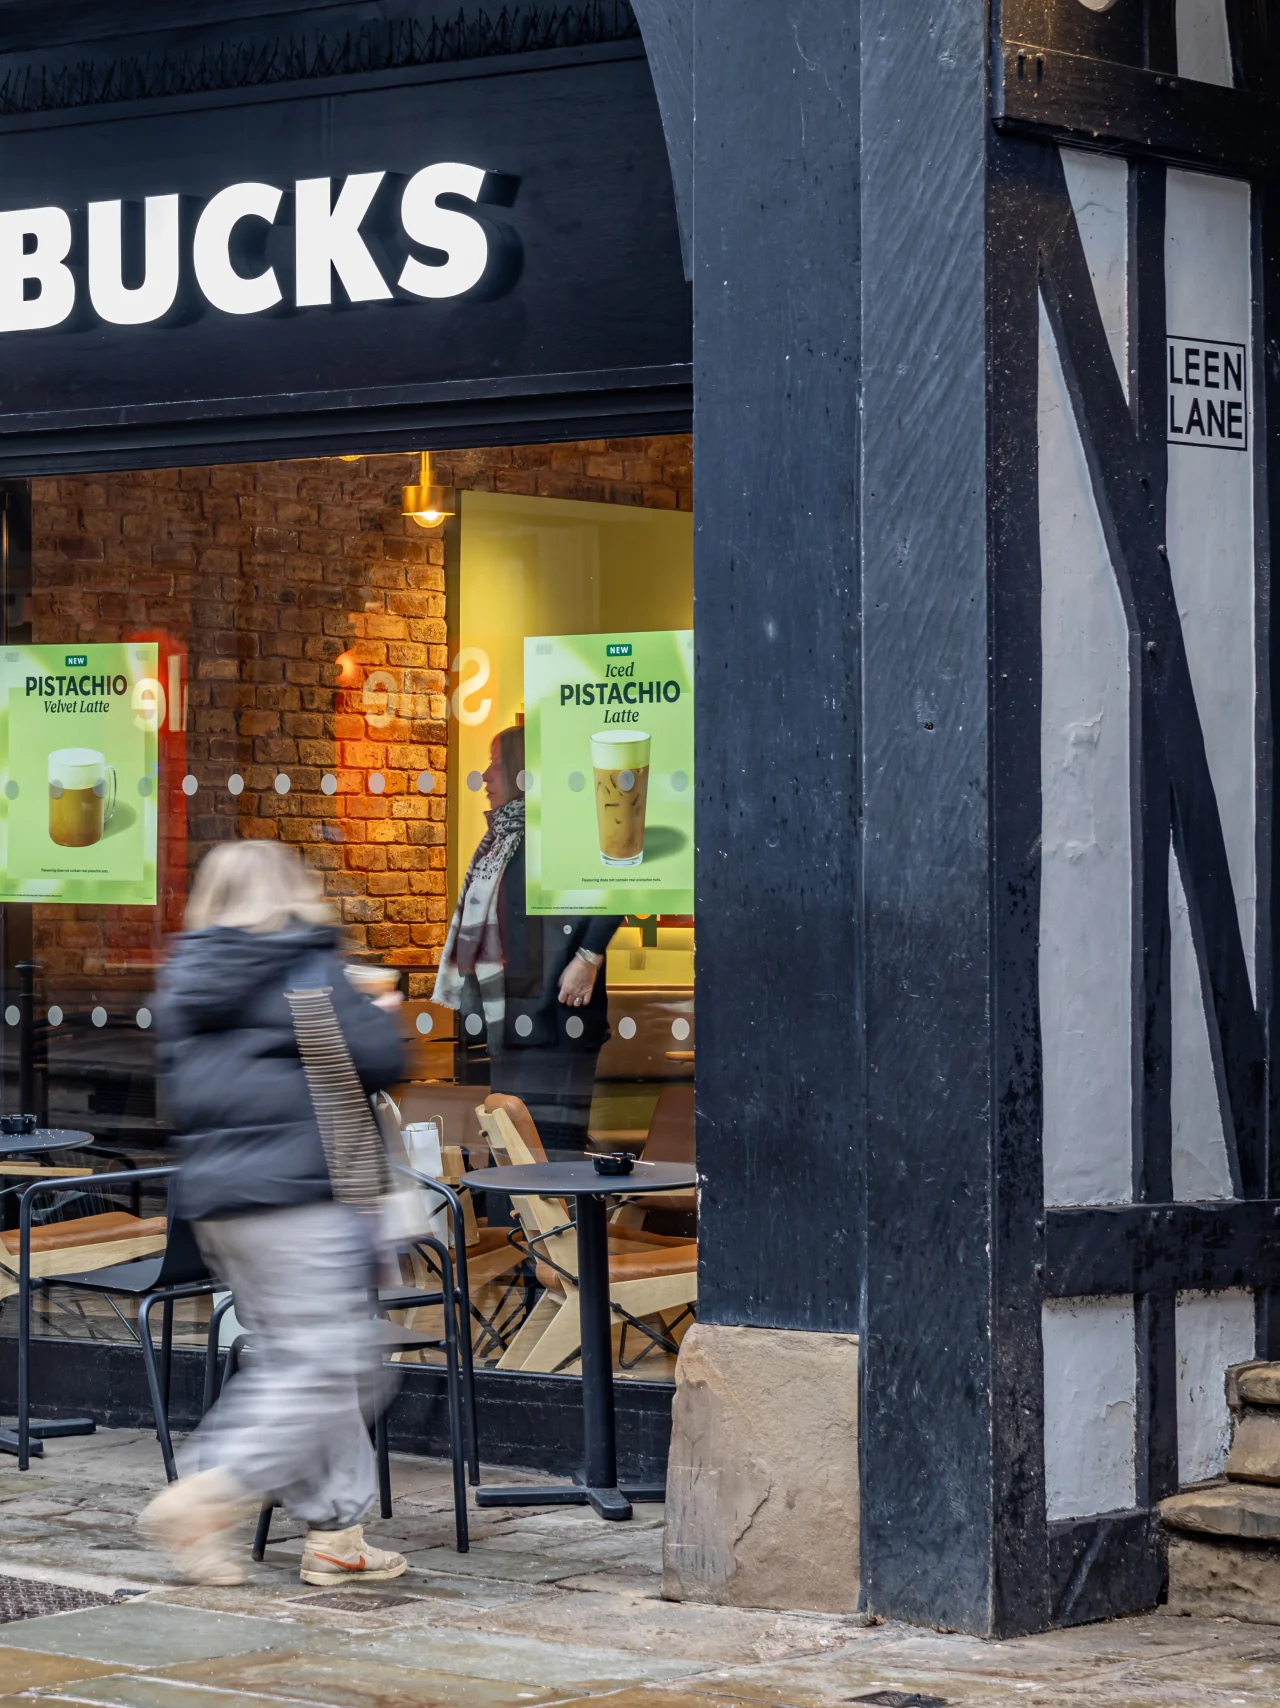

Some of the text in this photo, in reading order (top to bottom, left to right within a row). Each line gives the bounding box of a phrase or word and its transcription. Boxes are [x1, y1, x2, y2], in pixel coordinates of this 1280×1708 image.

[1169, 345, 1242, 391] LEEN
[1169, 395, 1243, 440] LANE
[609, 646, 629, 654] NEW
[68, 657, 85, 665] NEW
[605, 661, 635, 678] Iced
[26, 674, 128, 696] PISTACHIO
[560, 680, 681, 706] PISTACHIO
[44, 699, 110, 713] Velvet Latte
[603, 709, 640, 724] Latte
